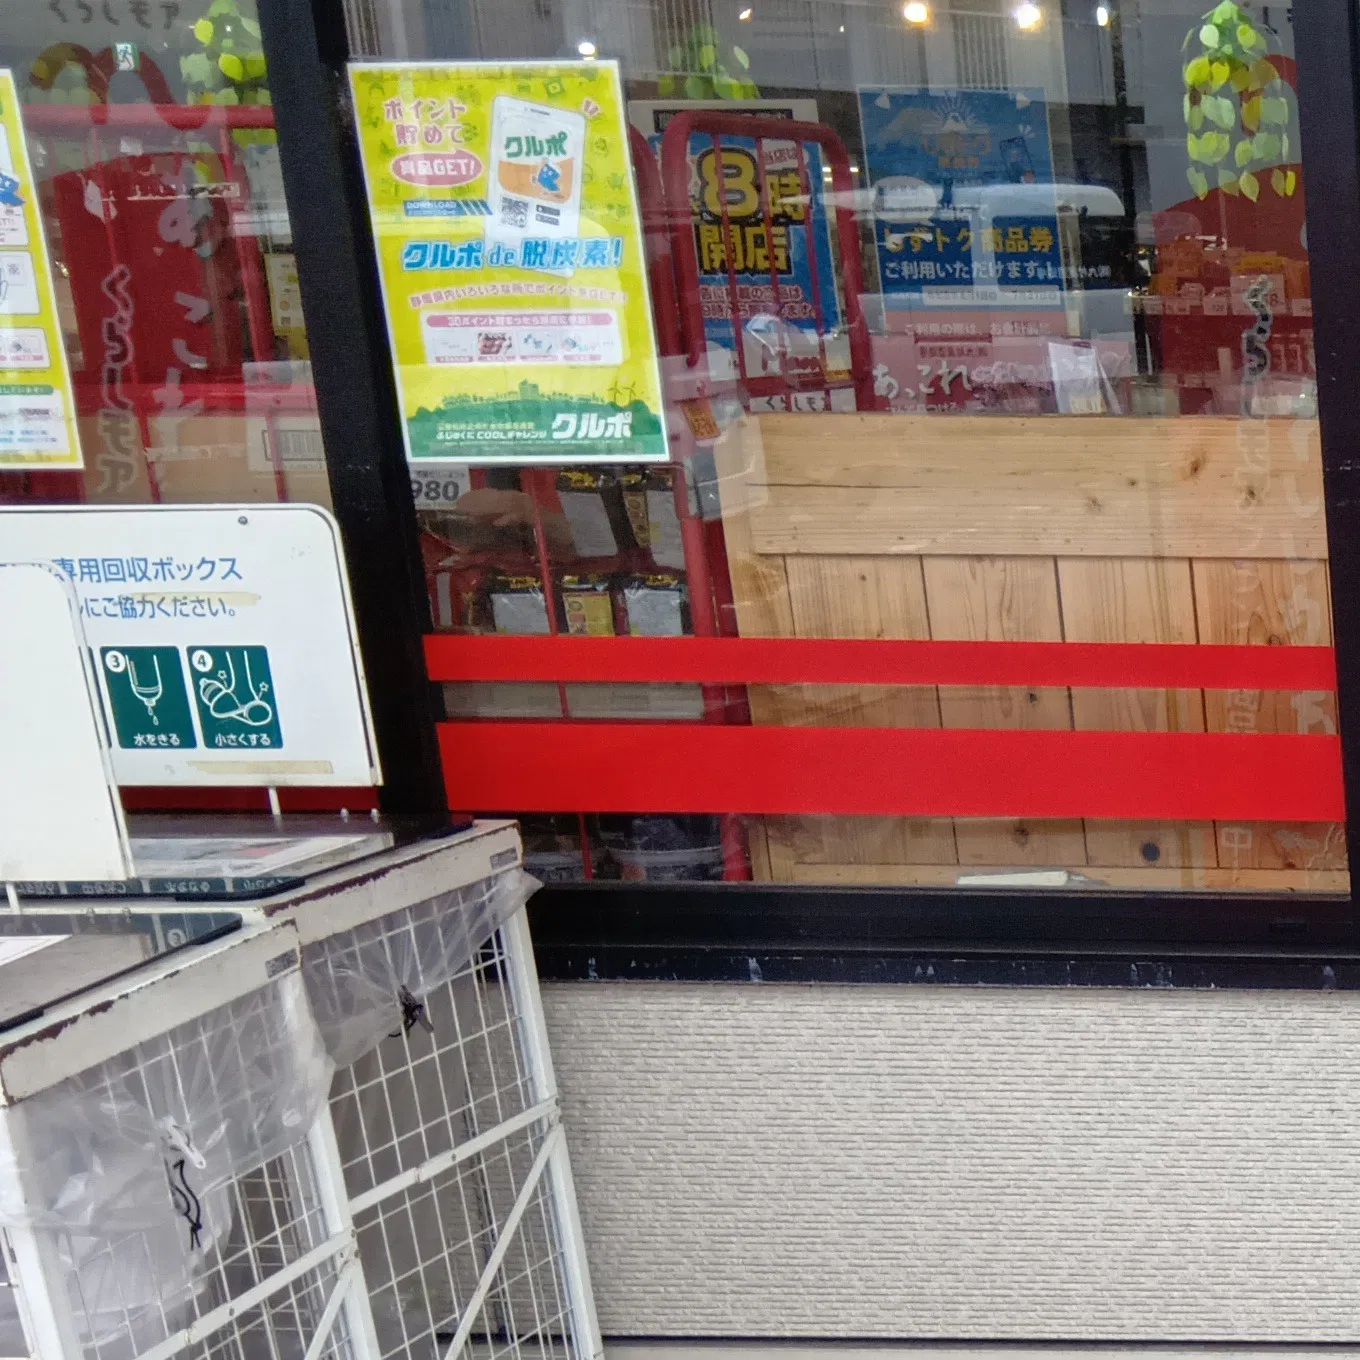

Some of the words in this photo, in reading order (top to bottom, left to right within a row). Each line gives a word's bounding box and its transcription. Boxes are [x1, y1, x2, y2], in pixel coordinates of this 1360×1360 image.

[384, 99, 466, 120] ポイント
[396, 124, 463, 145] 貯めて
[504, 132, 568, 158] クルポ
[403, 240, 484, 270] クルポ
[489, 243, 515, 267] de
[521, 237, 623, 269] 脱炭素!
[551, 411, 633, 440] クルポ
[80, 596, 236, 619] にご協力ください。
[133, 732, 181, 746] 水をきる
[214, 732, 272, 746] 小さくする
